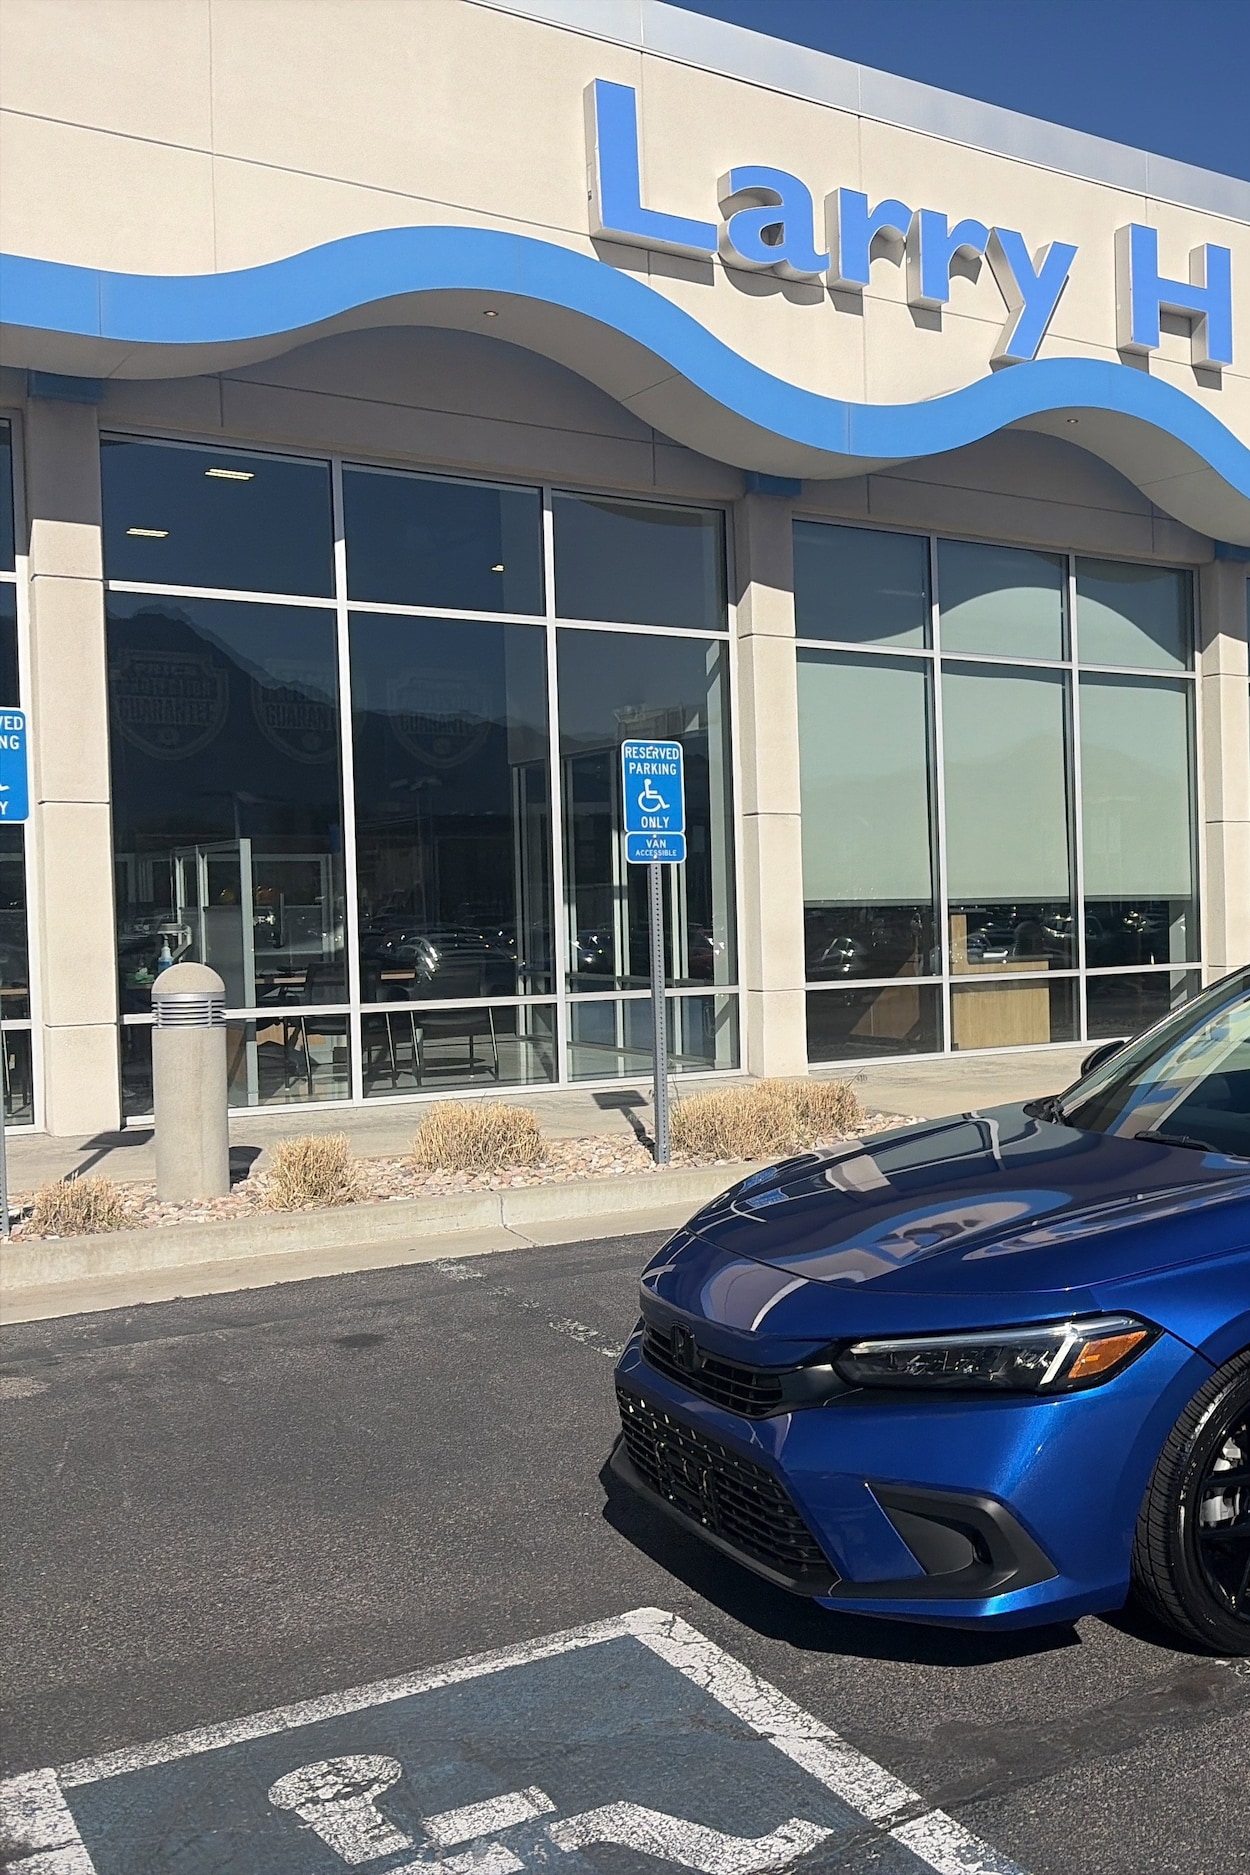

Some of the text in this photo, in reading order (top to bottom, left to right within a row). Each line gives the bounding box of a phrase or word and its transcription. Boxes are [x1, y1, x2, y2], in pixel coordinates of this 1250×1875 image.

[584, 78, 1079, 363] Larry
[1118, 223, 1232, 367] H
[625, 746, 679, 760] RESERVED
[629, 762, 677, 776] PARKING
[641, 816, 670, 829] ONLY
[646, 839, 667, 849] VAN
[635, 849, 677, 857] ACCESSIBLE
